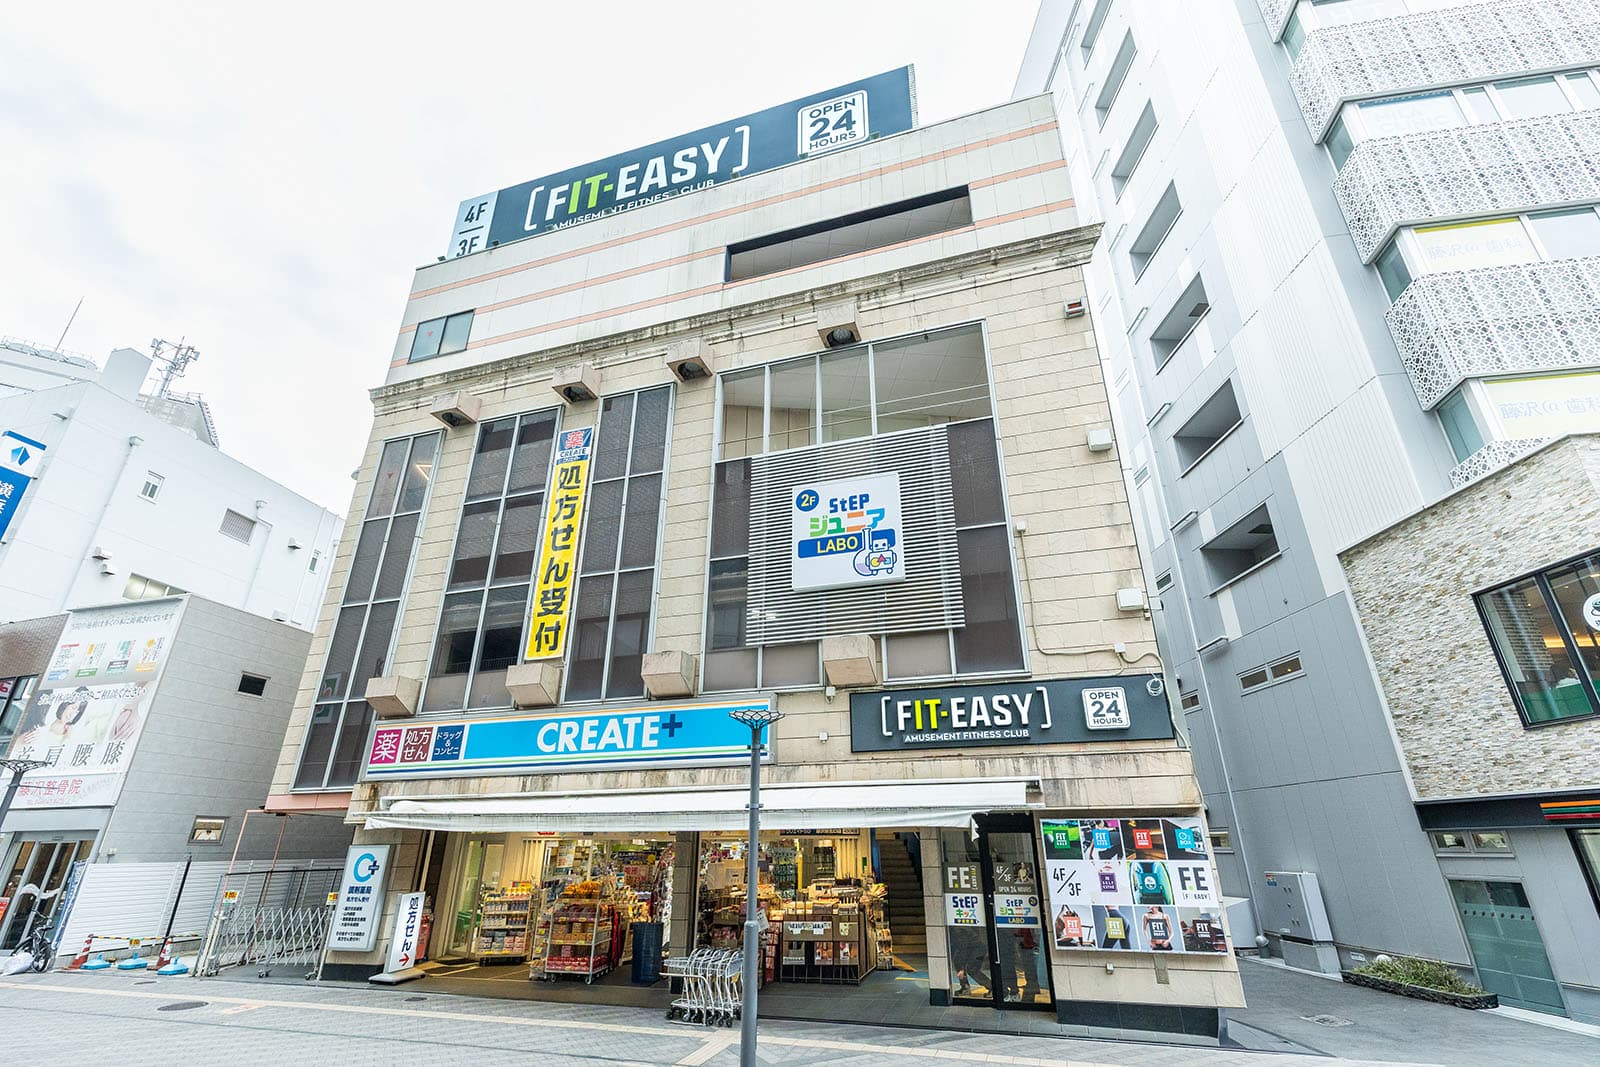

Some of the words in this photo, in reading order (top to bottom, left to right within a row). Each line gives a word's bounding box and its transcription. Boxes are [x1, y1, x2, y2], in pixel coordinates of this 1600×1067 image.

[809, 97, 856, 119] OPEN
[809, 109, 857, 142] 24
[809, 130, 857, 150] HOURS
[680, 179, 714, 195] CLUB
[464, 202, 488, 223] 4F
[456, 235, 480, 257] 3F
[801, 494, 816, 507] 2F
[810, 508, 885, 537] ジュニア
[817, 537, 858, 554] LABO
[535, 464, 581, 652] 処方せん受付
[1089, 691, 1119, 700] OPEN
[1091, 700, 1121, 717] 24
[1092, 716, 1123, 725] HOURS
[404, 729, 431, 746] 処方
[437, 730, 463, 740] ドラッグ
[904, 731, 961, 742] AMUSEMENT
[963, 729, 1002, 740] FITNESS
[1003, 728, 1029, 738] CLUB
[372, 732, 399, 761] 薬
[403, 745, 427, 760] せん
[434, 747, 459, 755] コンビニ
[1055, 832, 1066, 841] FIT
[1095, 832, 1107, 841] FIT
[1136, 832, 1147, 841] FIT
[1053, 868, 1066, 881] 4F
[1068, 883, 1082, 896] 3F
[1000, 907, 1031, 916] ジュニア
[402, 897, 420, 953] 処方せん
[1067, 920, 1079, 929] FIT
[1108, 920, 1120, 930] FIT
[1152, 921, 1164, 931] FIT
[1196, 923, 1208, 932] FIT
